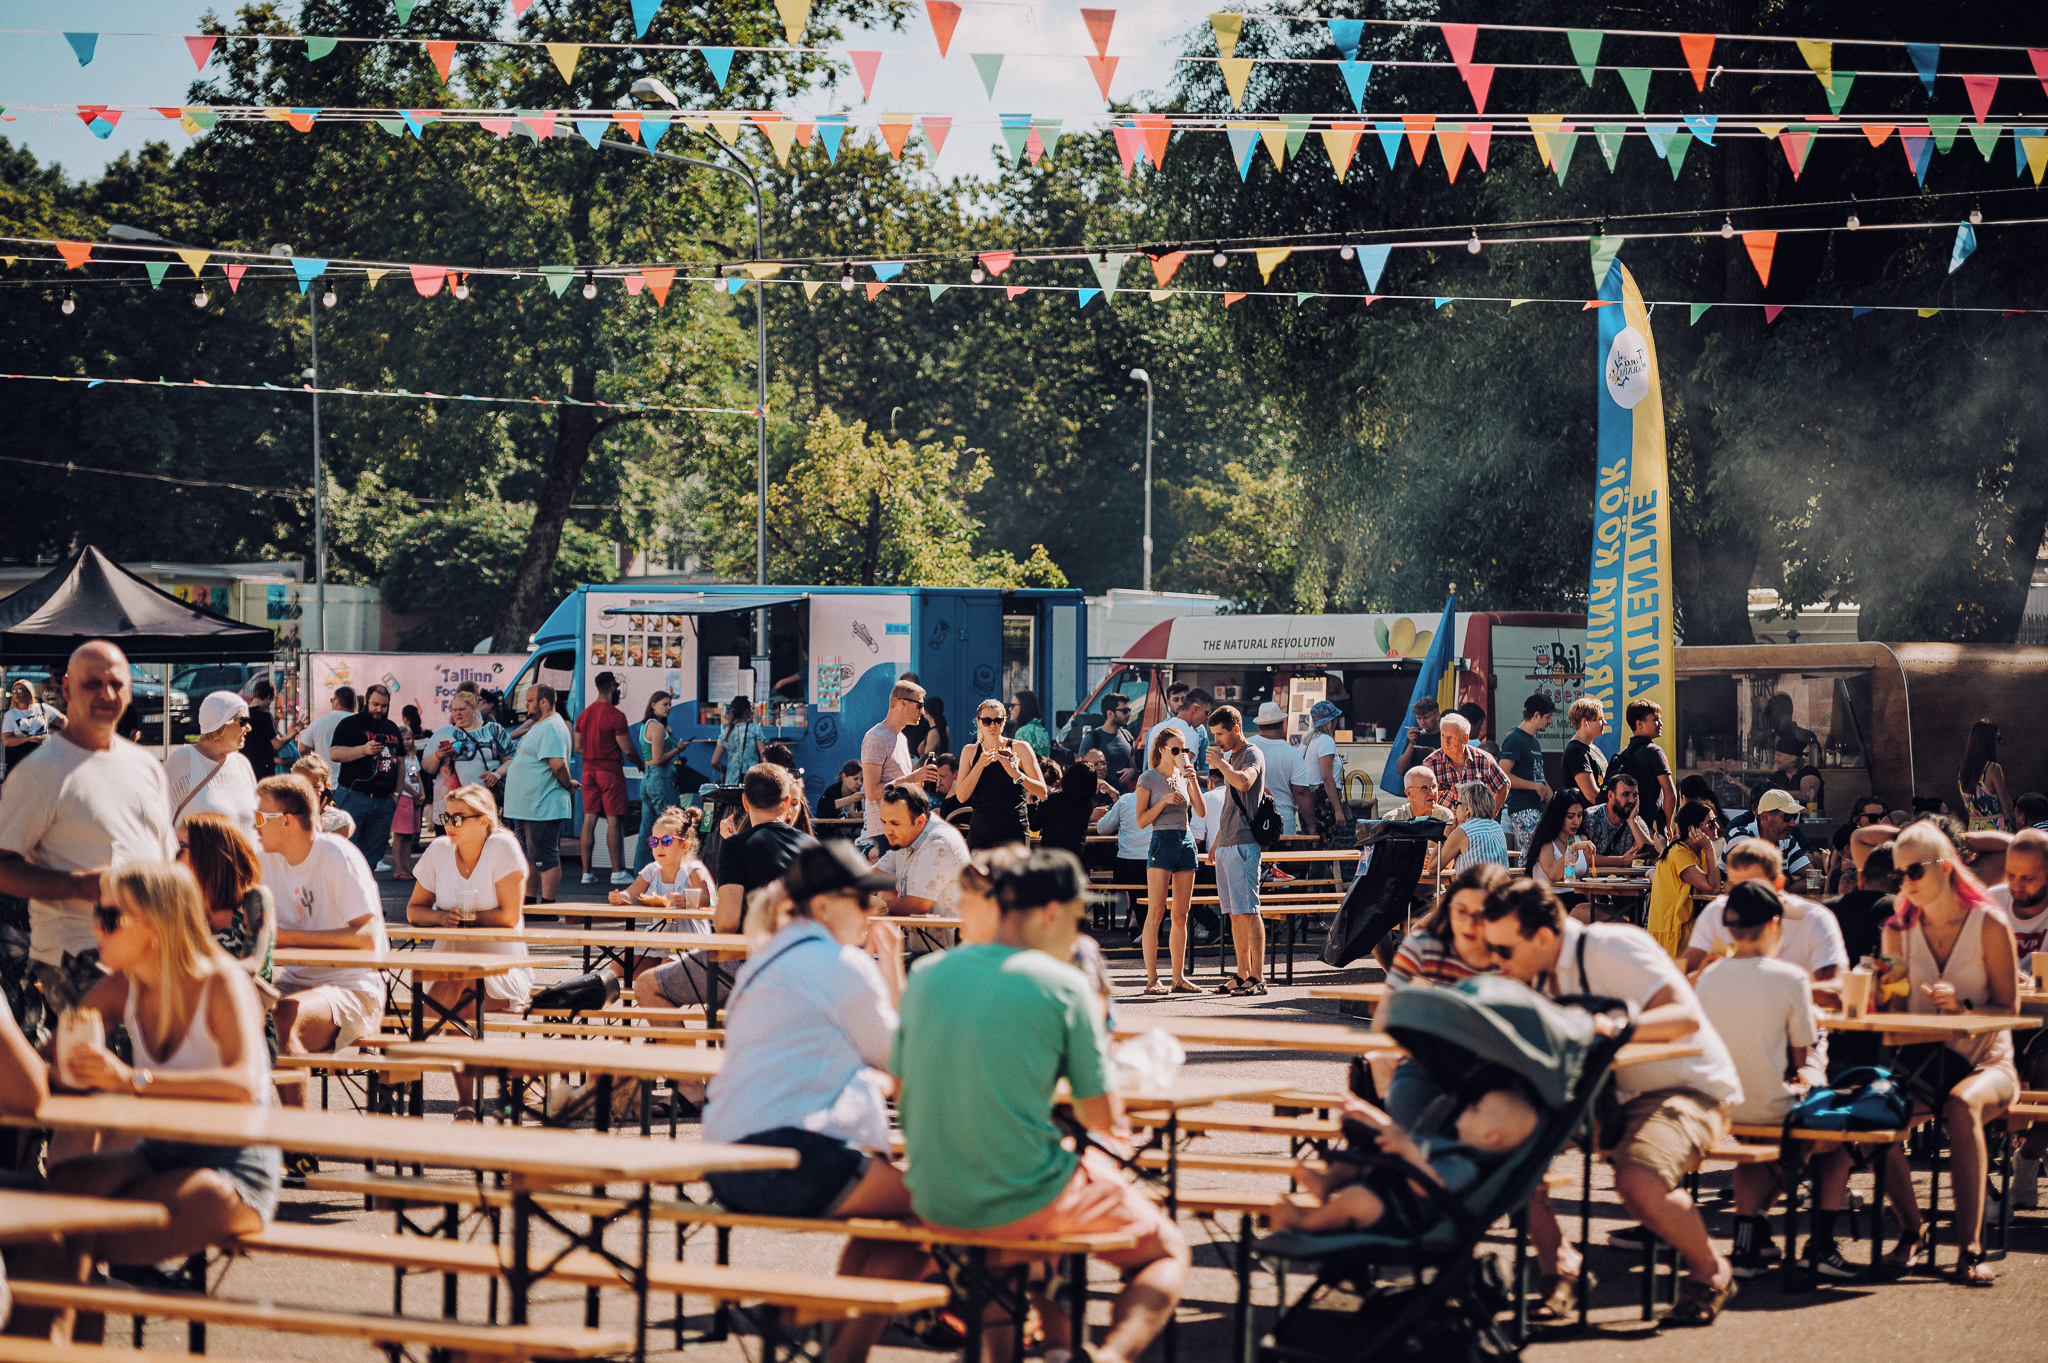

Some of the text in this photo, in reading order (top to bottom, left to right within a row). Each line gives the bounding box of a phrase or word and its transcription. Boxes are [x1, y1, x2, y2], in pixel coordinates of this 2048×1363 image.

[1203, 636, 1336, 651] THE NATURAL REVOLUTION
[1297, 650, 1333, 659] lactose free
[441, 668, 493, 683] Tallinn
[1533, 683, 1585, 704] deser
